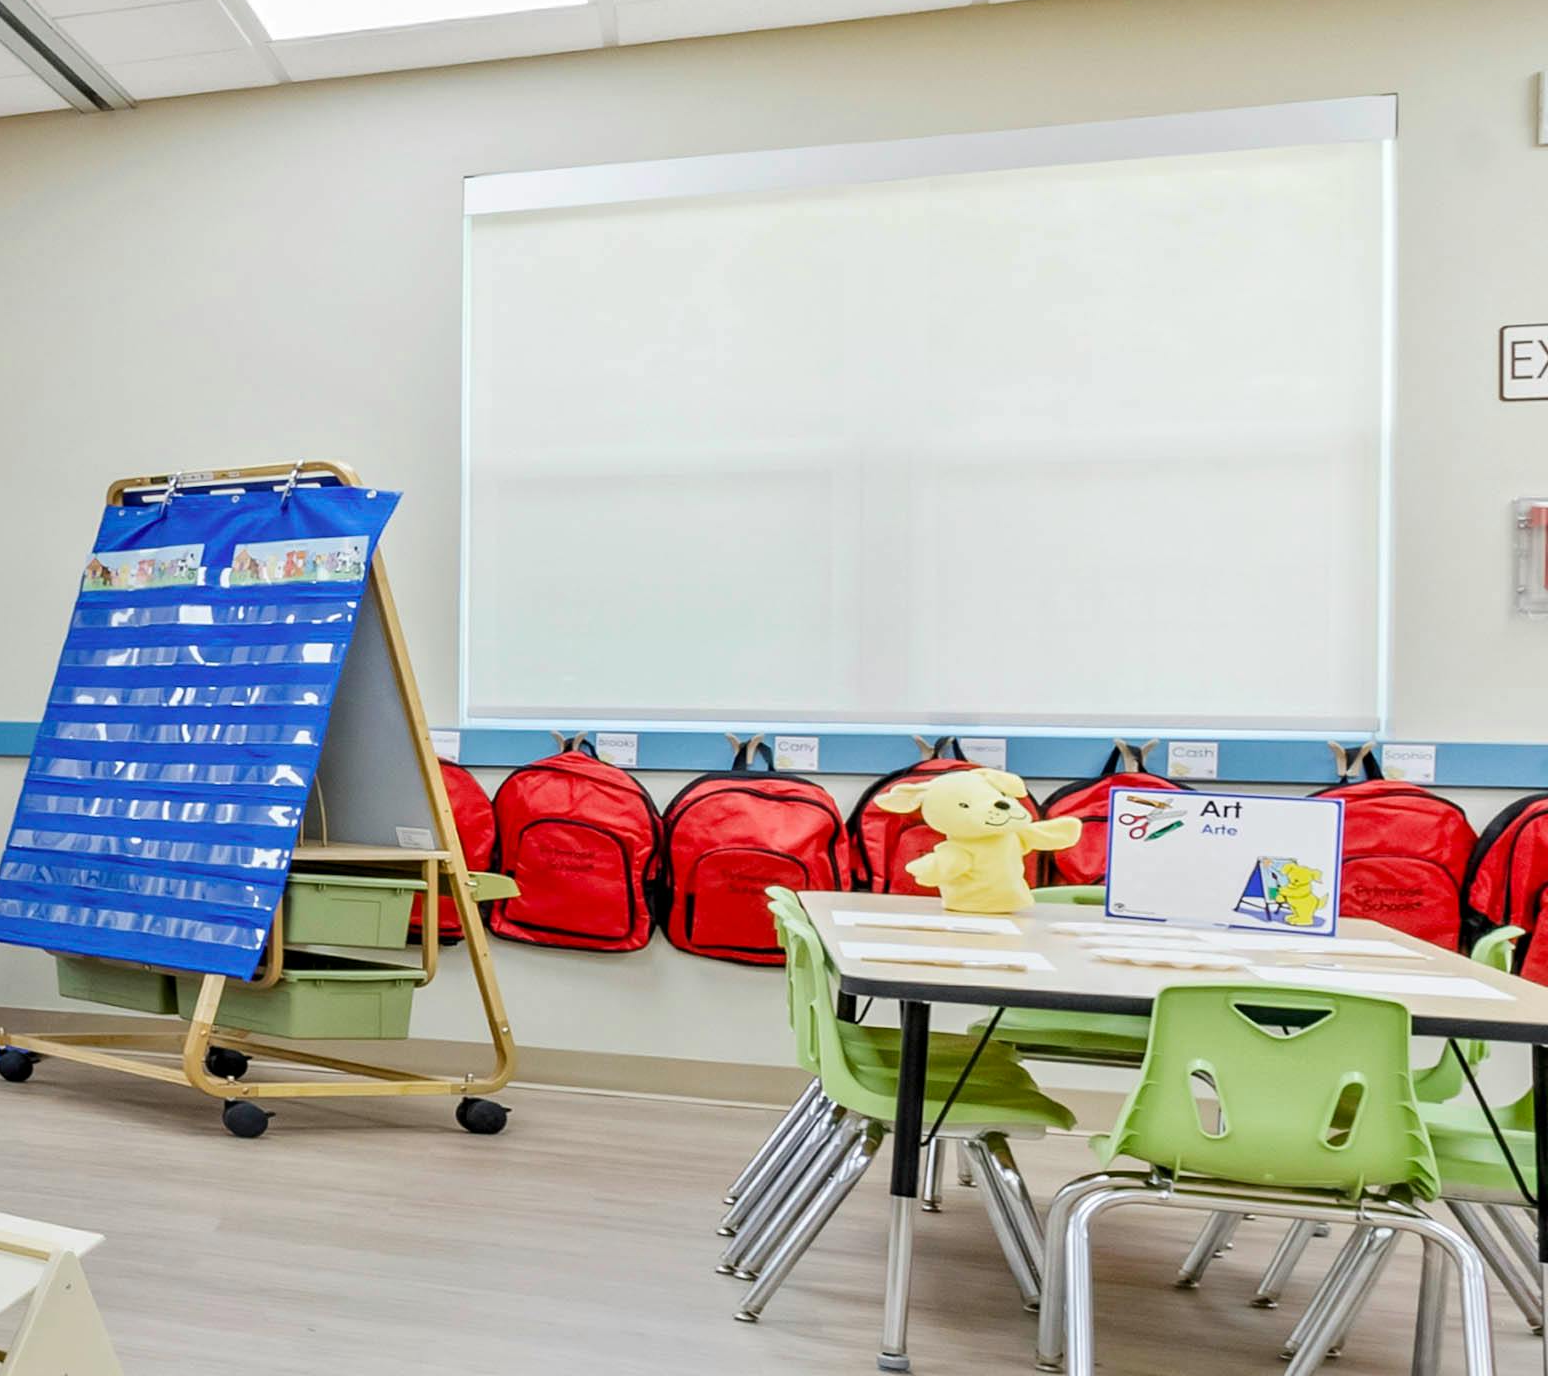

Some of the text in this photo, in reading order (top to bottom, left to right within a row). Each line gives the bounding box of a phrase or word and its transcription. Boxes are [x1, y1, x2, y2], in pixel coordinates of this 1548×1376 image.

[1172, 745, 1215, 758] Cash
[1200, 800, 1244, 820] Art
[1202, 824, 1238, 837] Arte
